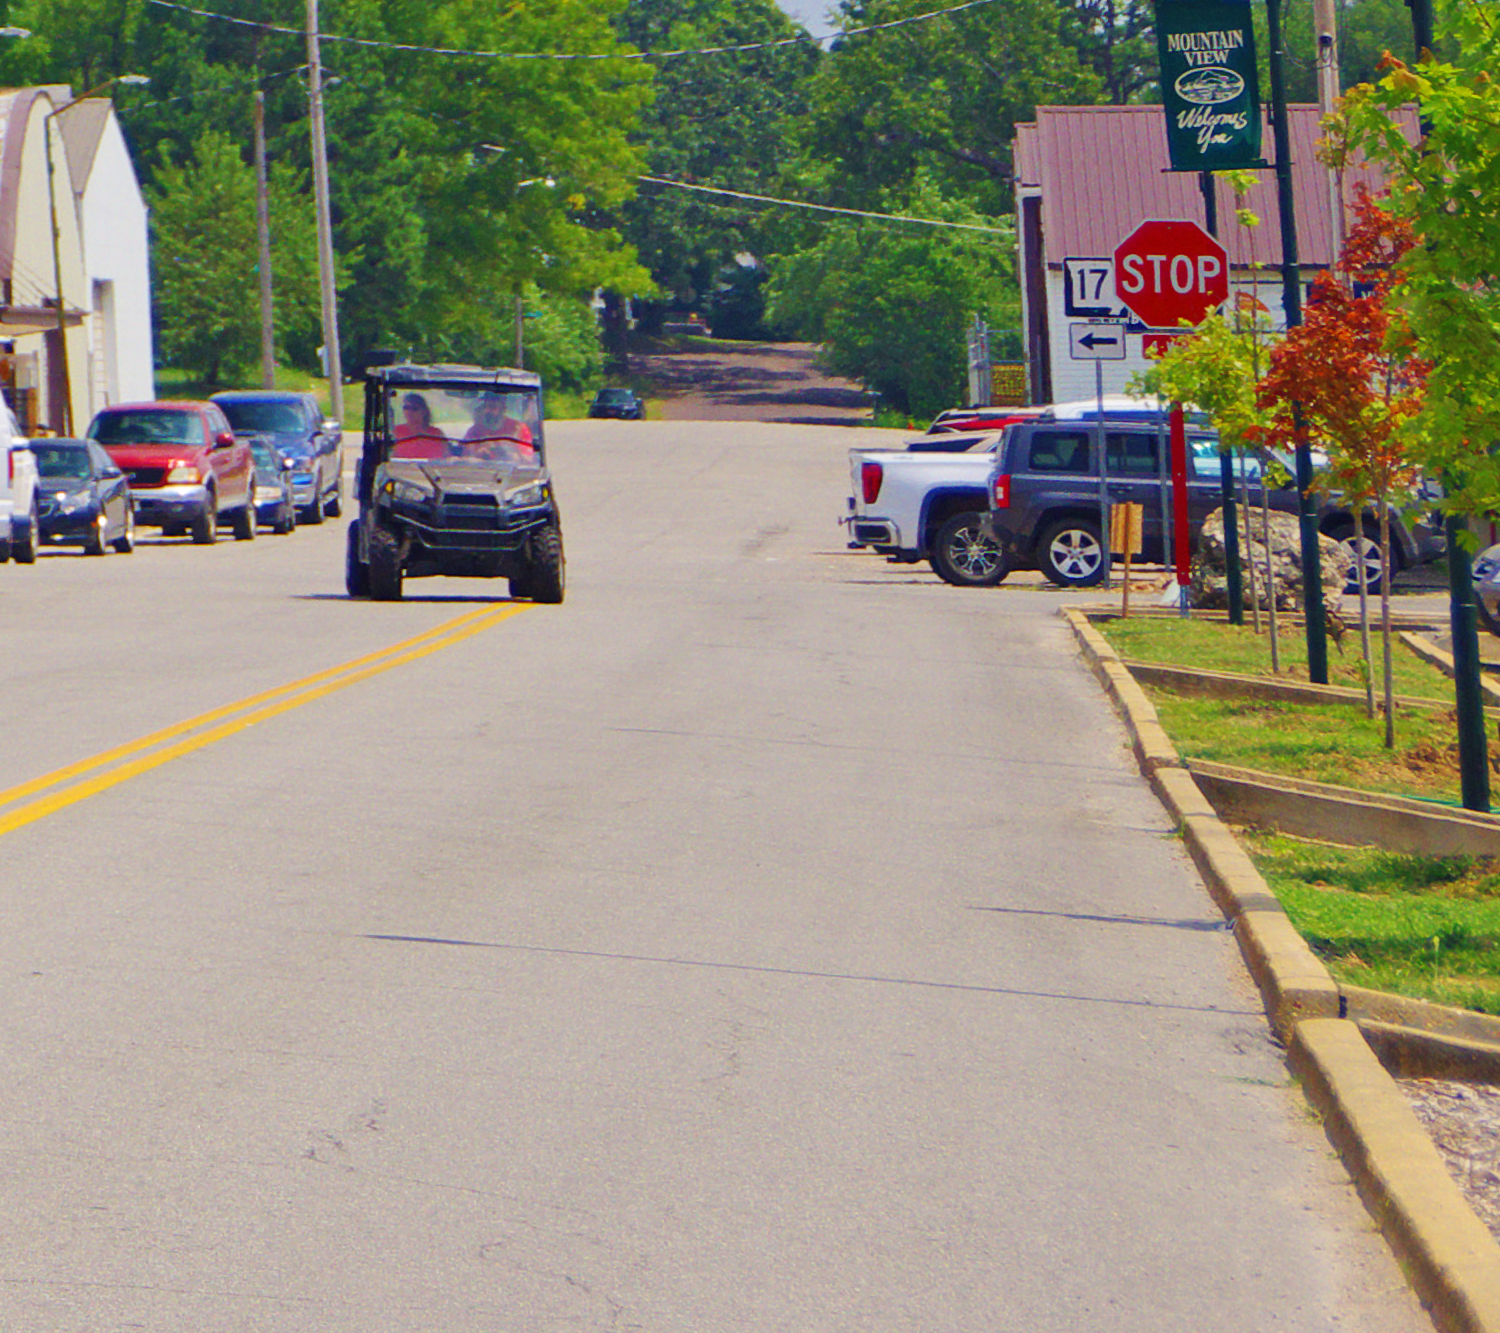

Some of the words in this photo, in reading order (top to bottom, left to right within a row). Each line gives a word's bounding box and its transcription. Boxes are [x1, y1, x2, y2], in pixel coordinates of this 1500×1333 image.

[1167, 30, 1244, 52] MOUNTAIN
[1184, 50, 1230, 66] VIEW
[1176, 106, 1248, 129] Welcomes
[1197, 126, 1233, 153] You
[1077, 268, 1108, 300] 17
[1121, 254, 1221, 294] STOP
